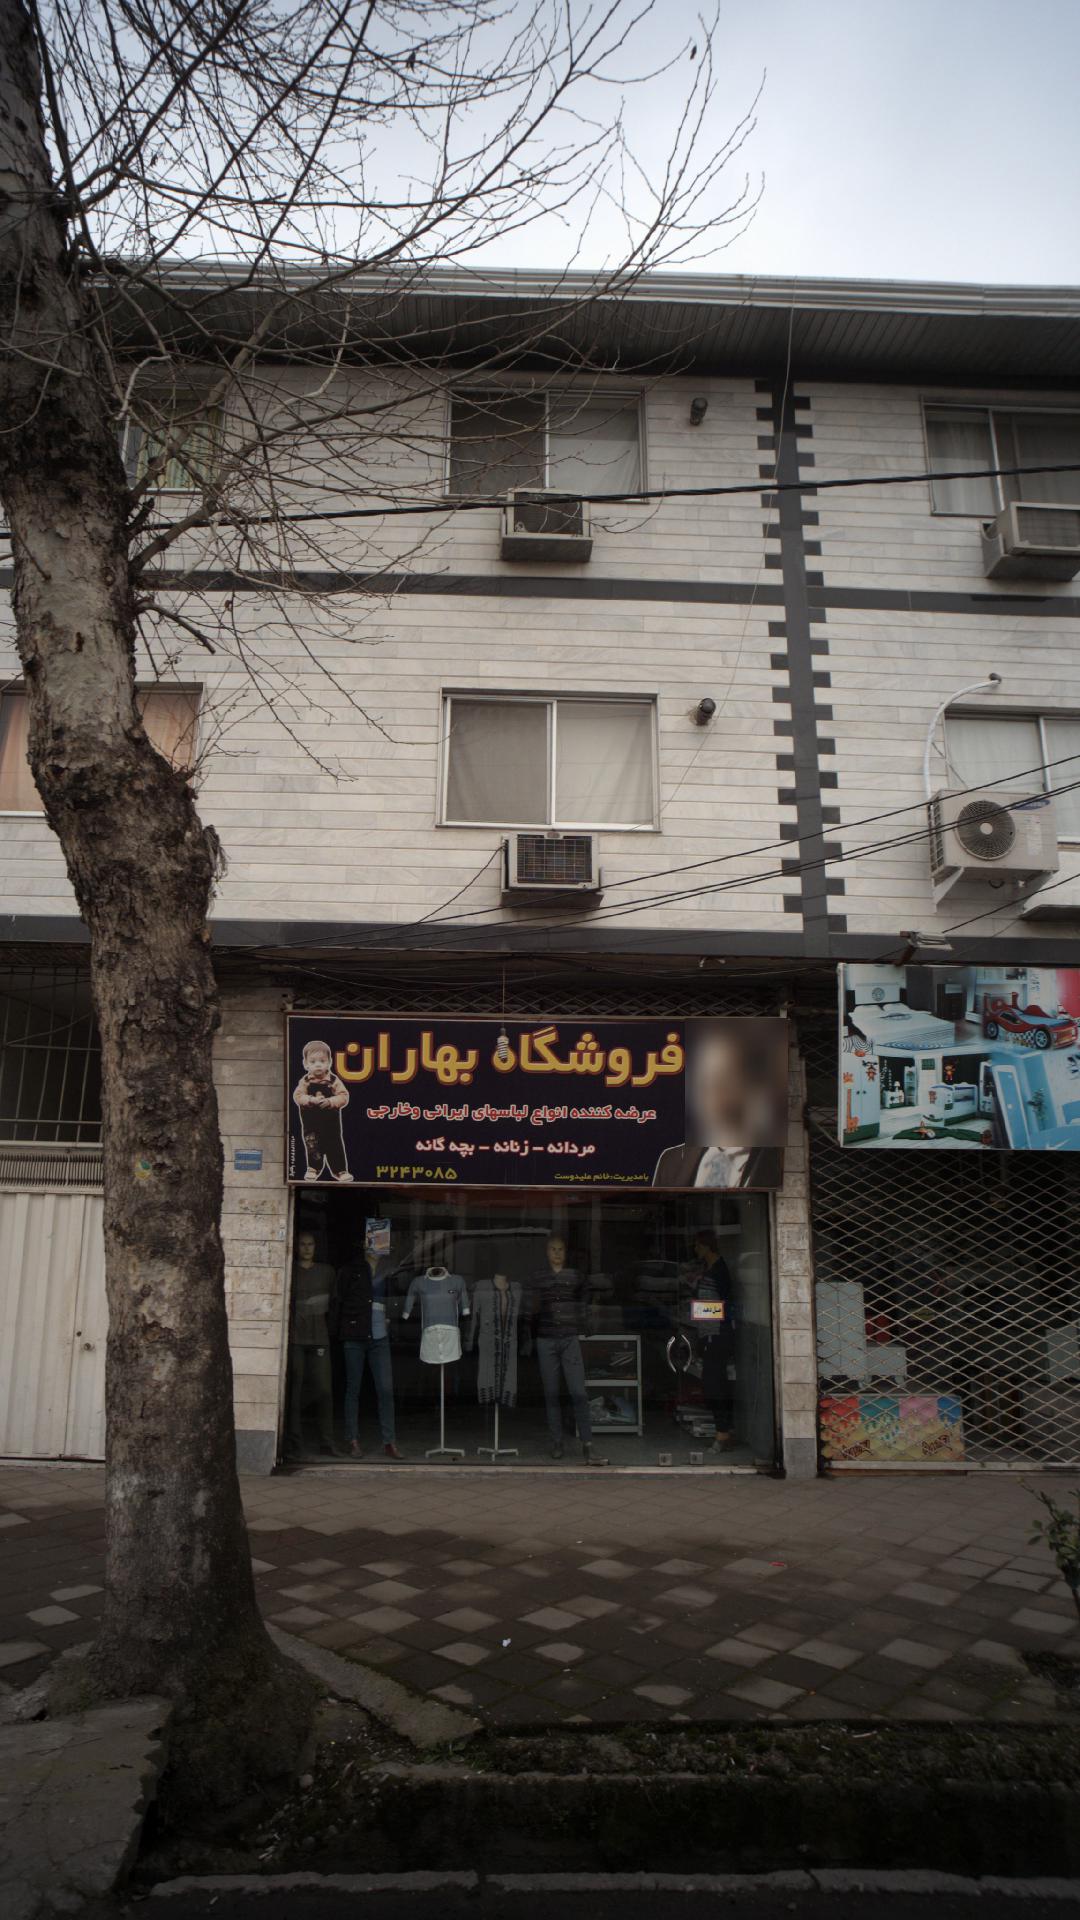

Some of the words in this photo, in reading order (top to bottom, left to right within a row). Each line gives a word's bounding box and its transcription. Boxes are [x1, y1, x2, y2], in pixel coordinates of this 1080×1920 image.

[335, 1030, 479, 1083] بهاران
[493, 1025, 684, 1087] فروشگاه
[423, 1104, 469, 1120] ایرانی
[472, 1103, 528, 1122] لباسهای
[531, 1105, 568, 1125] انواع
[570, 1104, 612, 1119] کننده
[614, 1105, 657, 1123] عرضه
[415, 1136, 446, 1151] گانه
[449, 1141, 475, 1157] بچه
[493, 1139, 529, 1156] زنانه
[547, 1141, 596, 1157] مردانه
[376, 1165, 458, 1180] ۳۲۴۳۰۸۵
